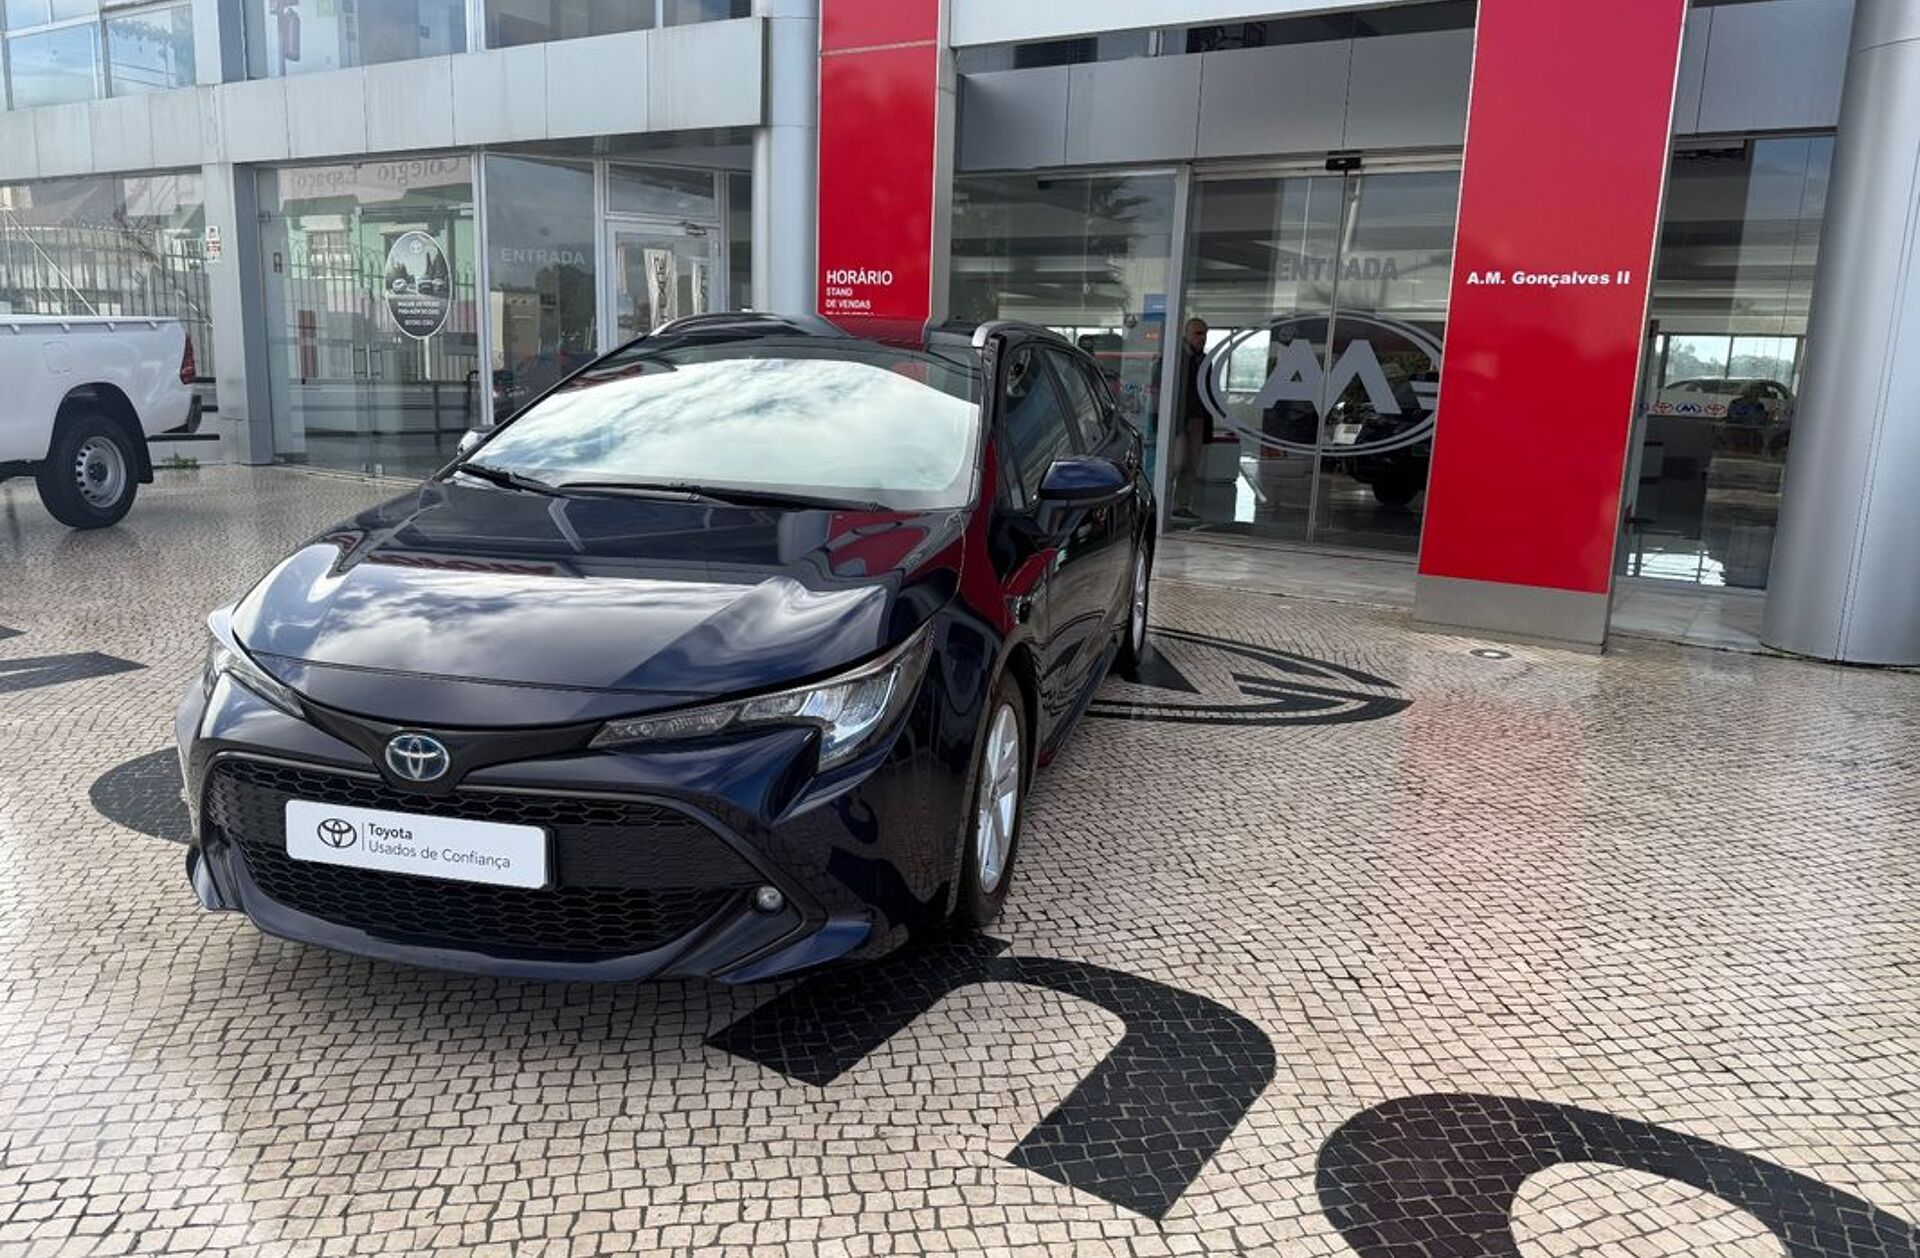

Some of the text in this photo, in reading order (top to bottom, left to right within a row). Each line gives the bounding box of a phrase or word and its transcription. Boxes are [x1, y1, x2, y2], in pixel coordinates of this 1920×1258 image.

[501, 248, 586, 266] ENTRADA
[826, 267, 893, 286] HORÁRIO
[1467, 270, 1631, 288] A.M. Gonçalves II
[826, 287, 853, 297] STAND
[825, 299, 871, 310] DE VENDAS
[368, 822, 414, 840] Toyota
[368, 840, 511, 869] Usados de Confiança
